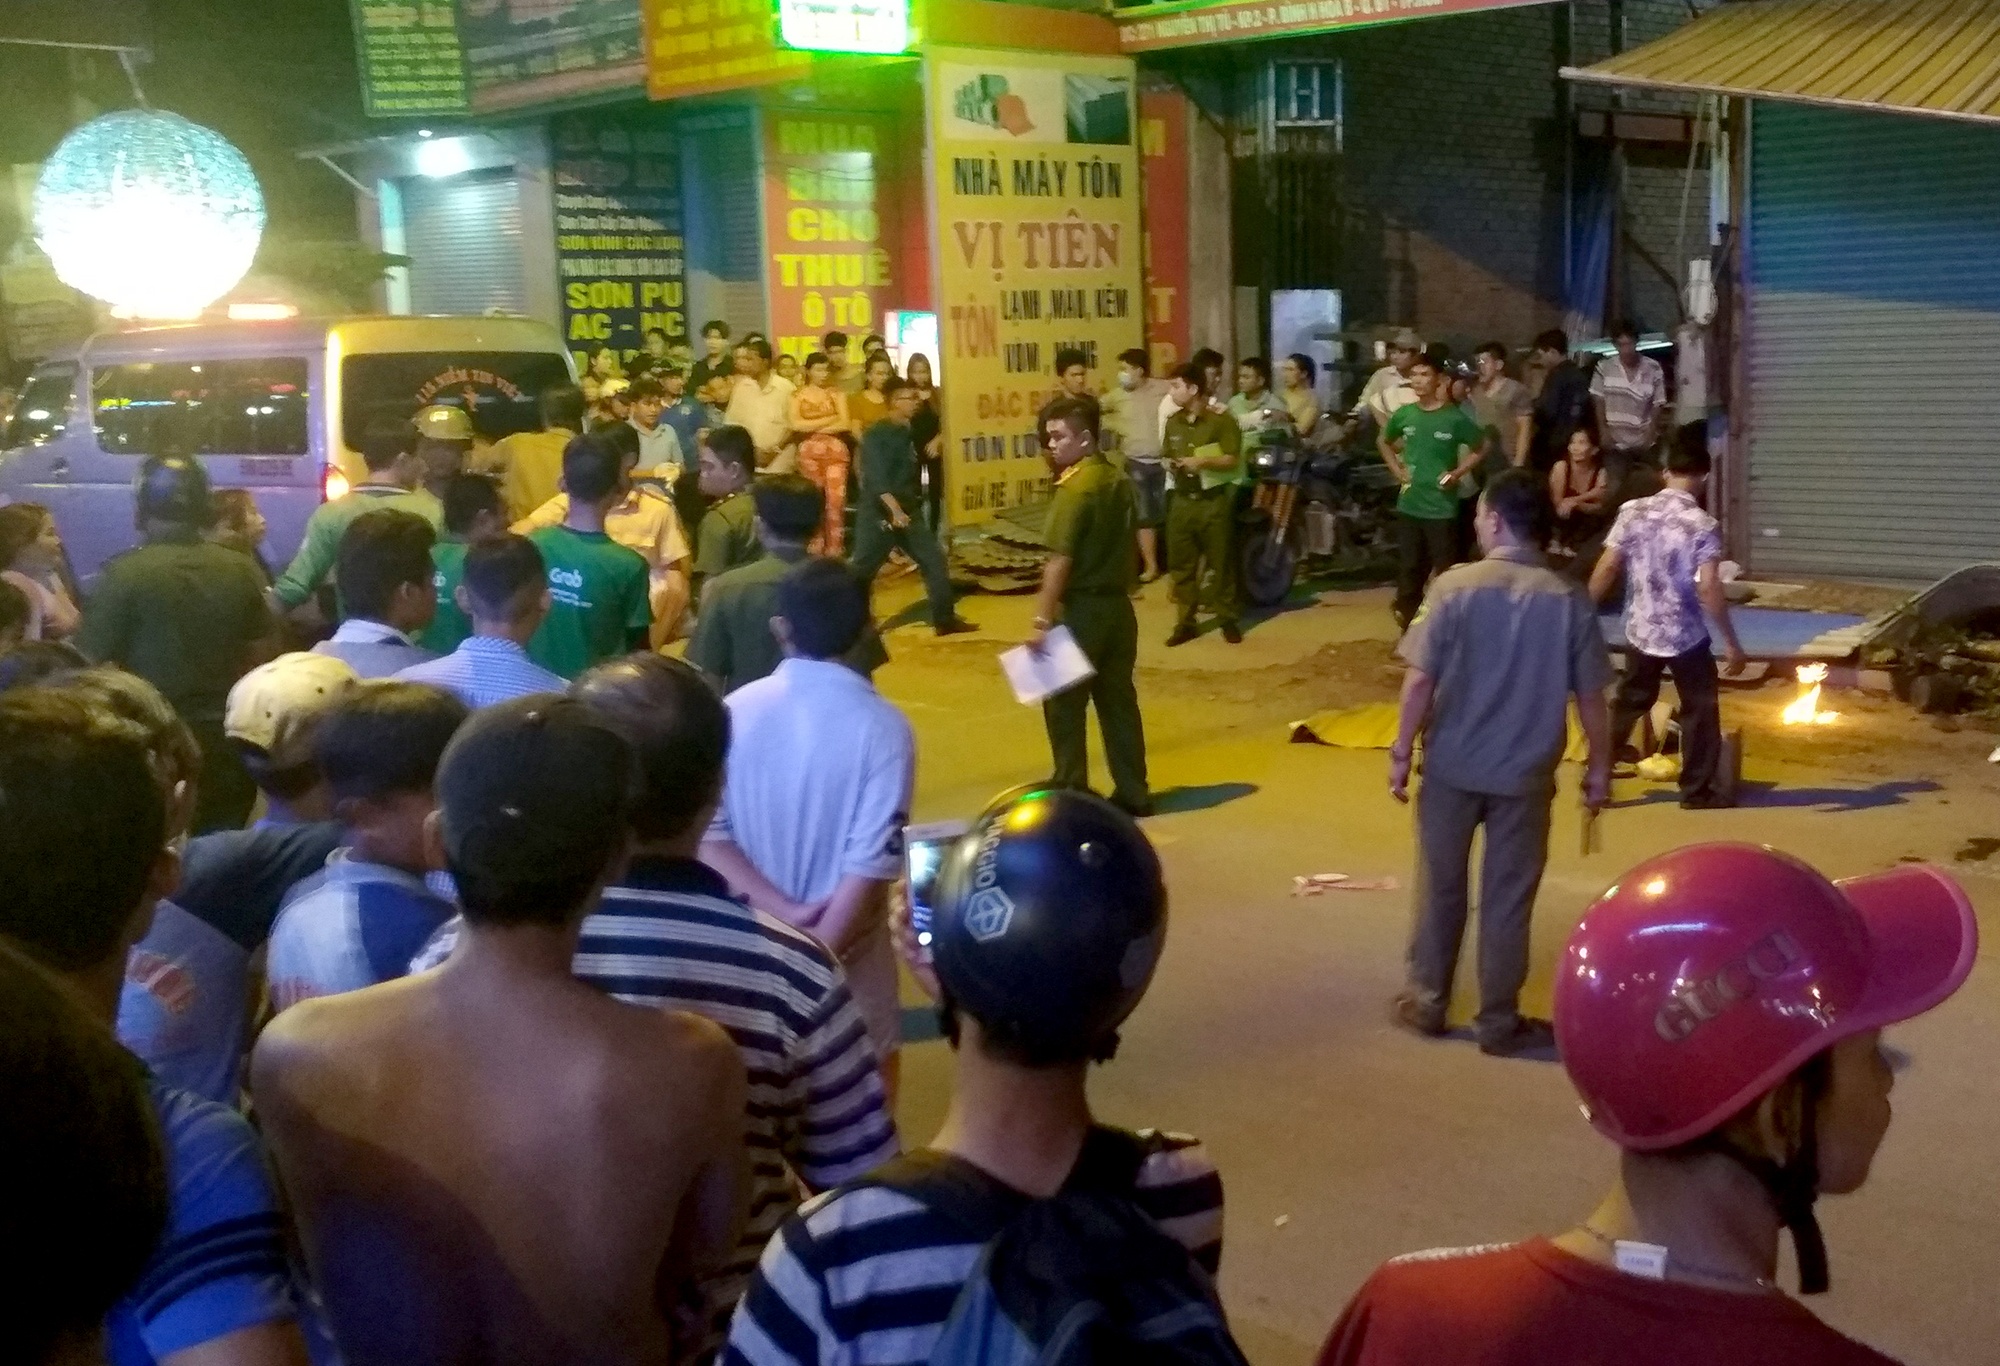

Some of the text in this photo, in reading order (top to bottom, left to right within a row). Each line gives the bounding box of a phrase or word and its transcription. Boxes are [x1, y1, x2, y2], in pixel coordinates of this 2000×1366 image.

[953, 151, 1122, 199] NHÀ MÁY TÔN
[953, 208, 1121, 283] VỊ TIÊN
[773, 248, 893, 288] THUÊ
[640, 281, 684, 308] PU
[802, 291, 872, 328] Ô TÔ
[568, 312, 613, 340] AC
[549, 566, 583, 588] Grab
